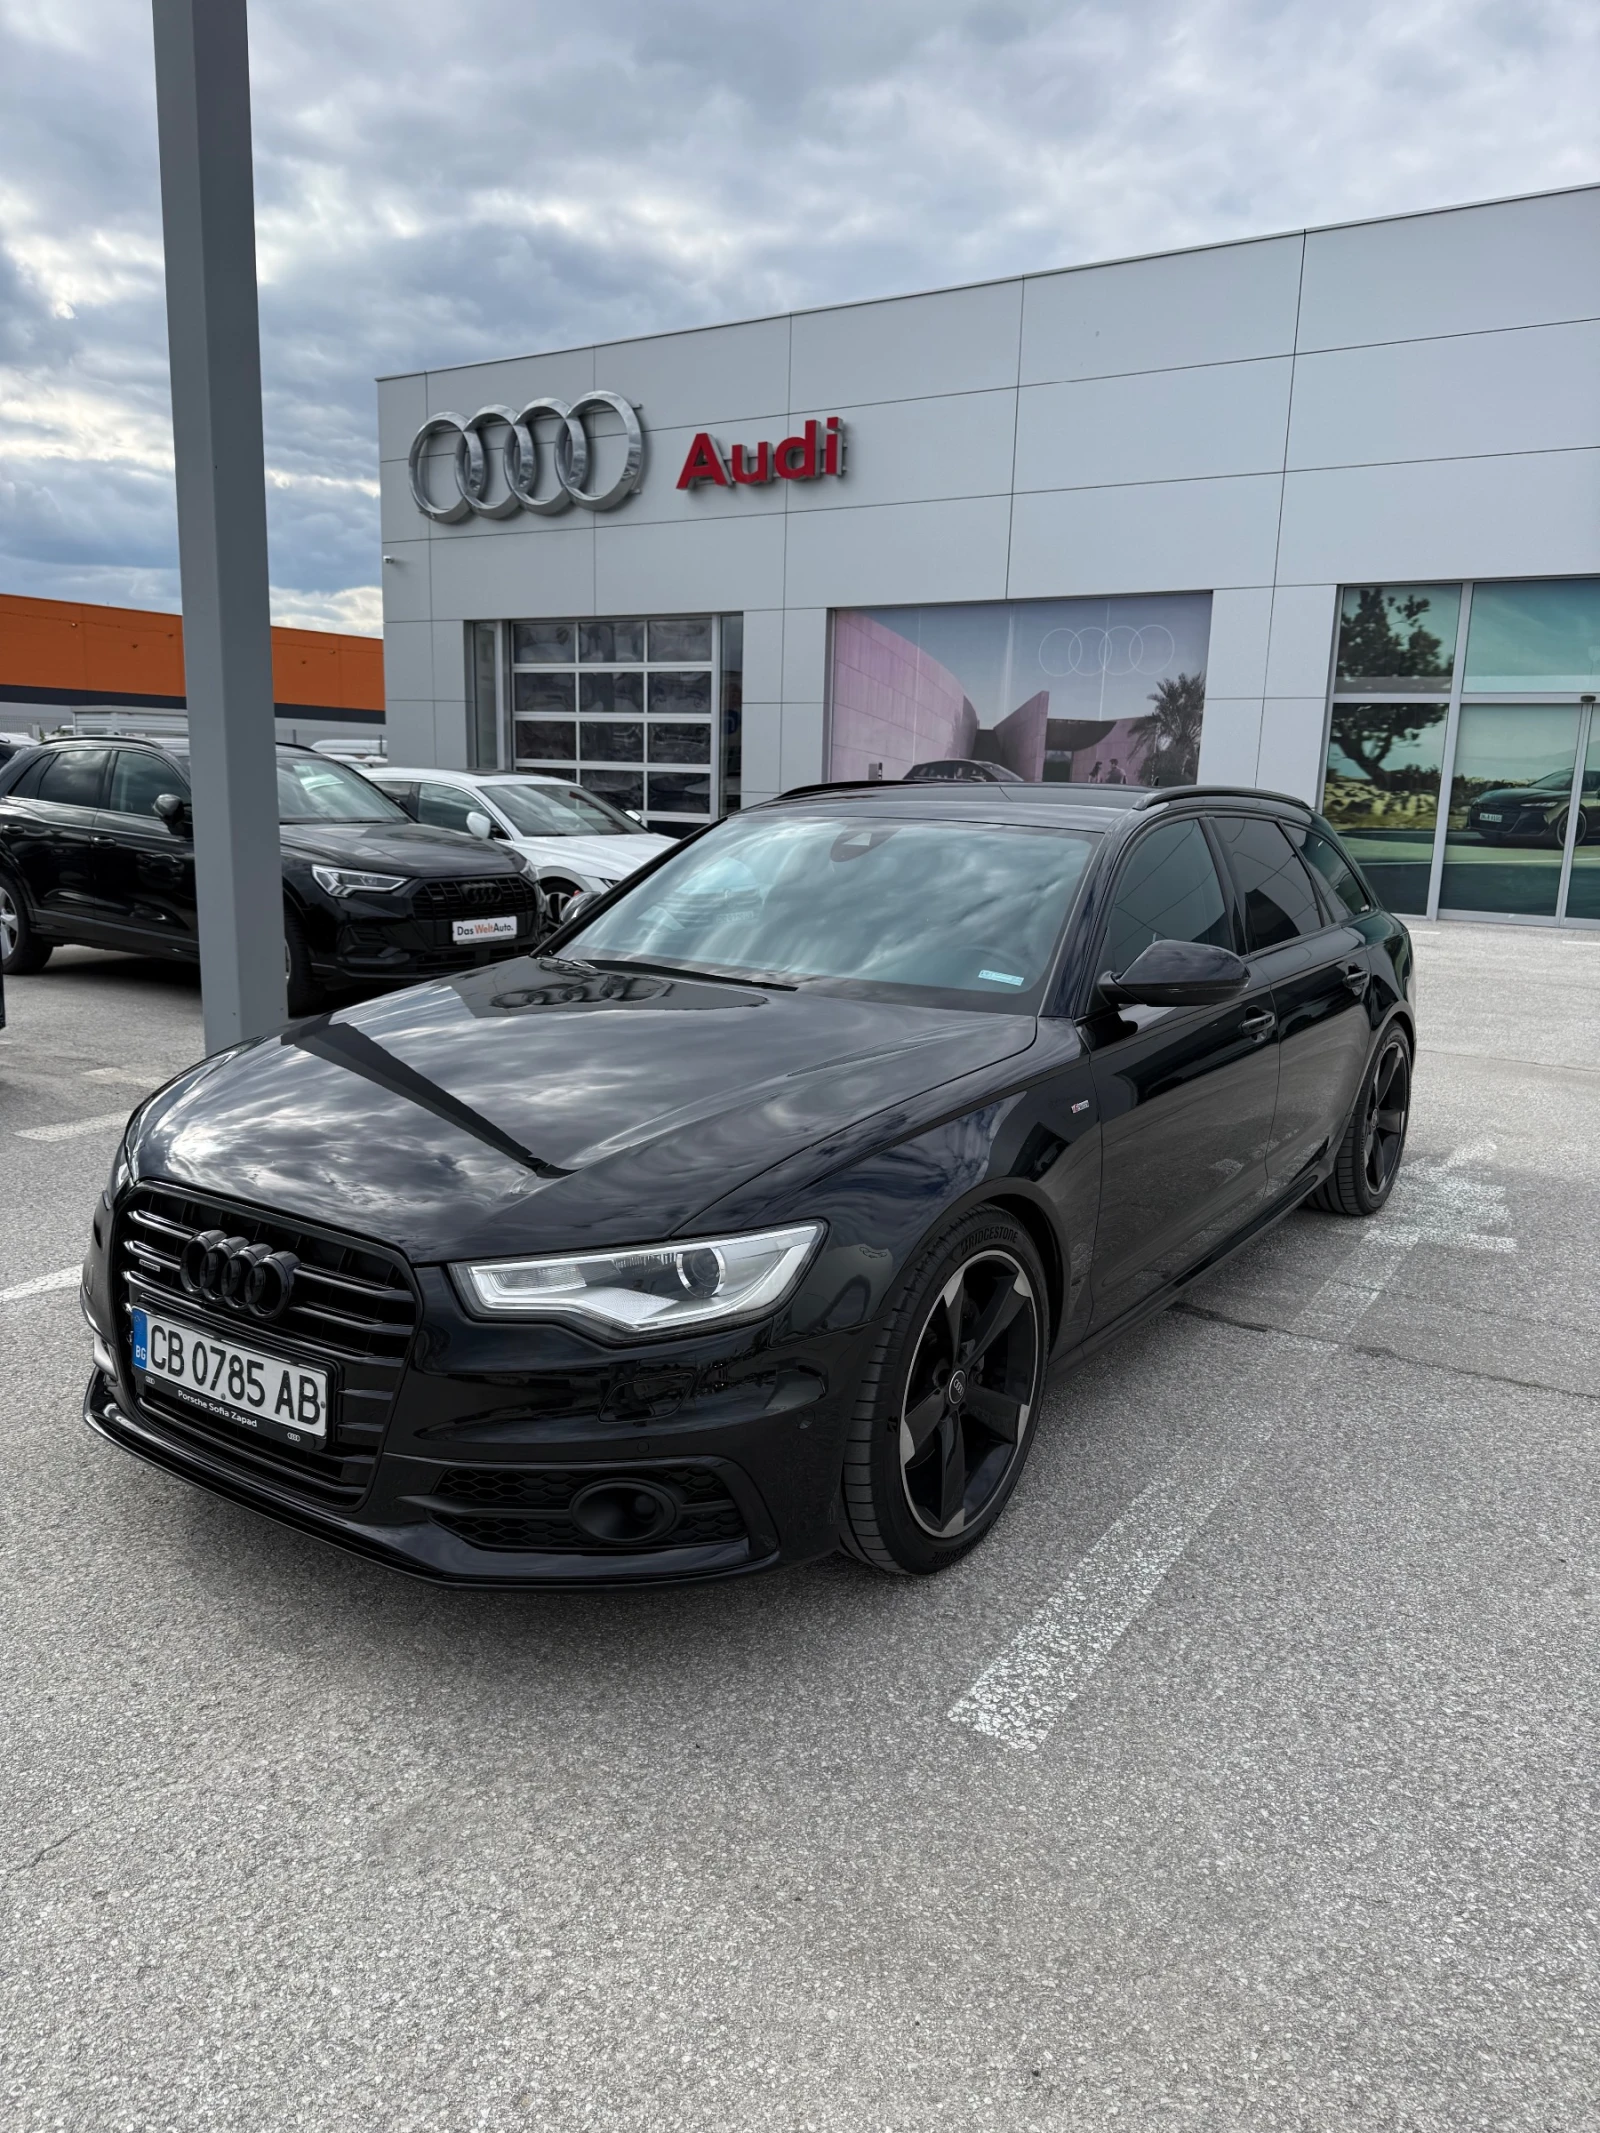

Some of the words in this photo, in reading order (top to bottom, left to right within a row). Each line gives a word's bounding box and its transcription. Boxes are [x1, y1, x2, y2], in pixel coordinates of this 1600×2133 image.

[676, 416, 842, 490] Audi
[457, 926, 474, 936] Das
[960, 1226, 1019, 1256] BRIDGESTONE
[135, 1344, 147, 1361] BG
[150, 1324, 185, 1378] CB
[192, 1340, 266, 1408] 0785
[274, 1369, 321, 1426] AB
[177, 1389, 208, 1409] Porsche
[208, 1402, 230, 1418] Sofia
[230, 1410, 258, 1428] Zapad
